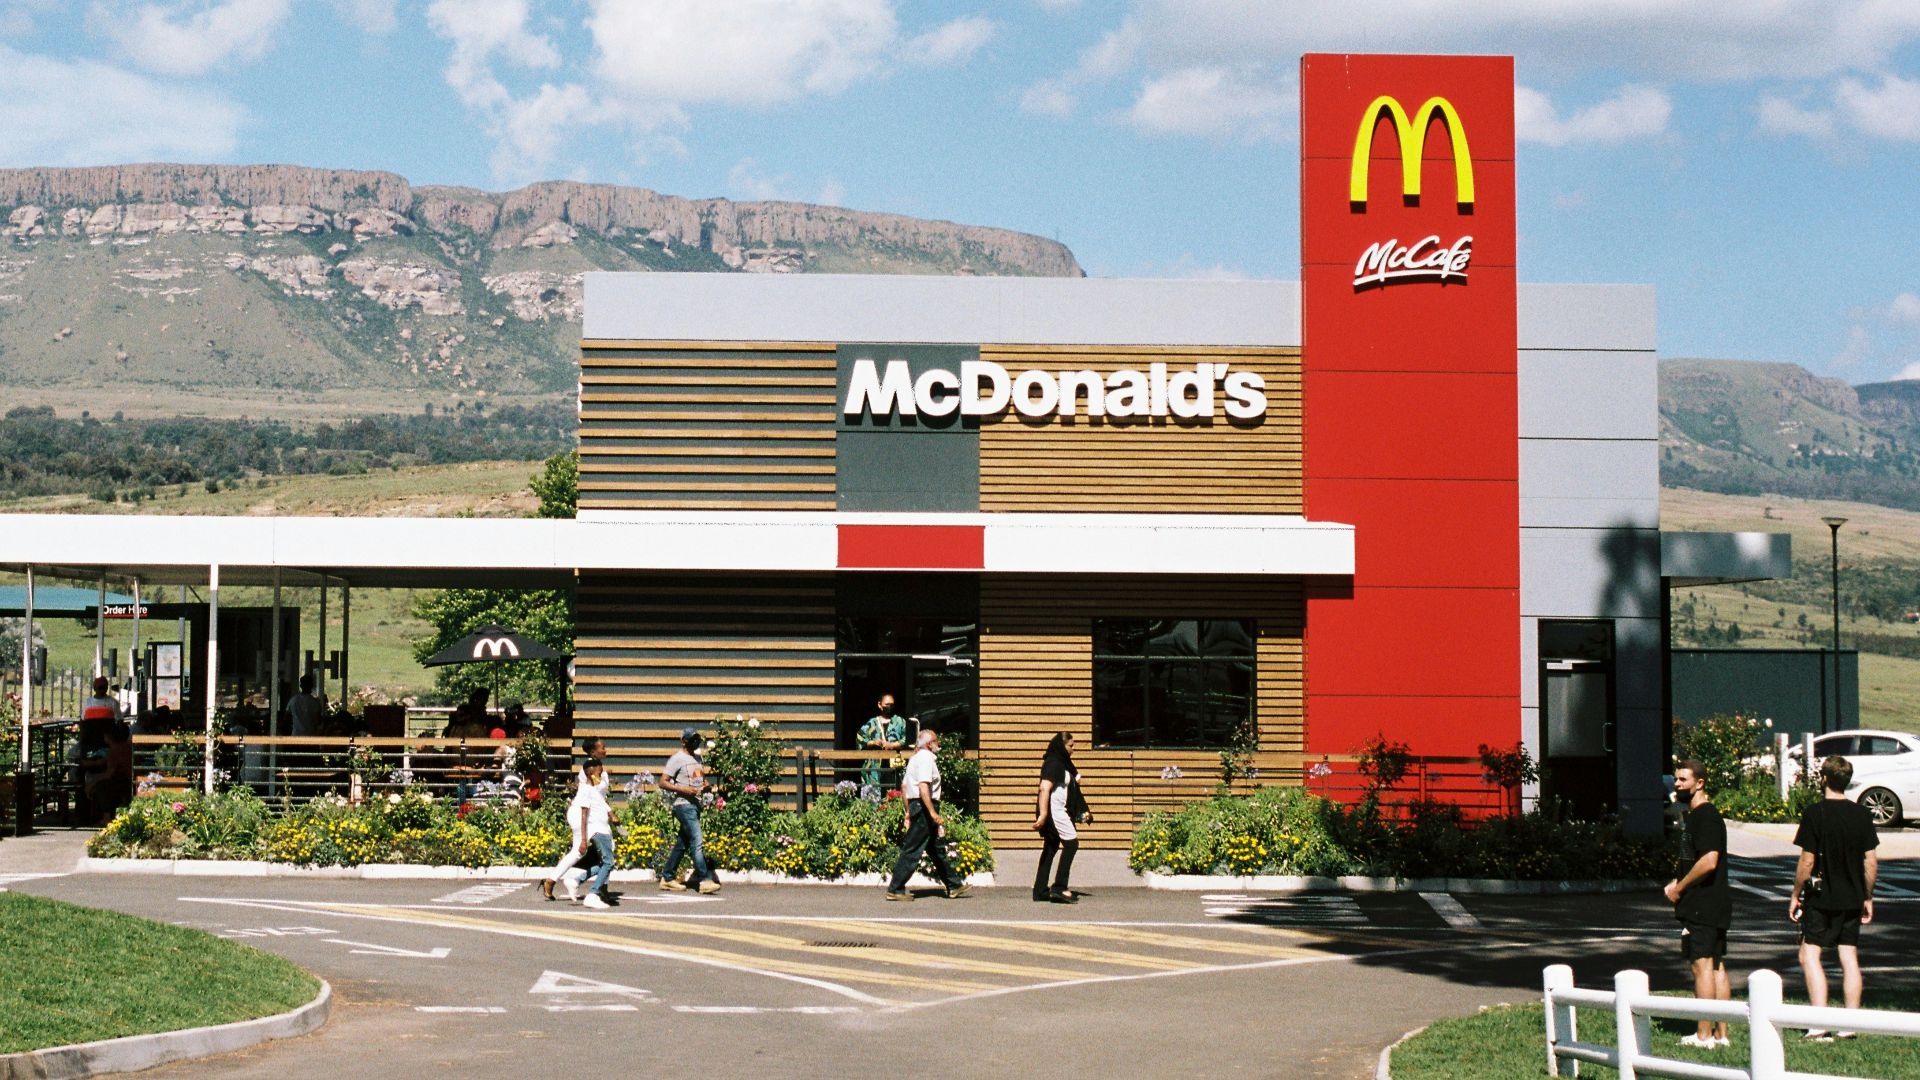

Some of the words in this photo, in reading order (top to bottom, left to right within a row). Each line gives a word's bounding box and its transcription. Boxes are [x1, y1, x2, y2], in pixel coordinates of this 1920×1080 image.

[1353, 235, 1474, 281] McCafé
[843, 359, 1267, 419] McDonald's
[103, 605, 126, 614] Order
[128, 605, 148, 614] Hre
